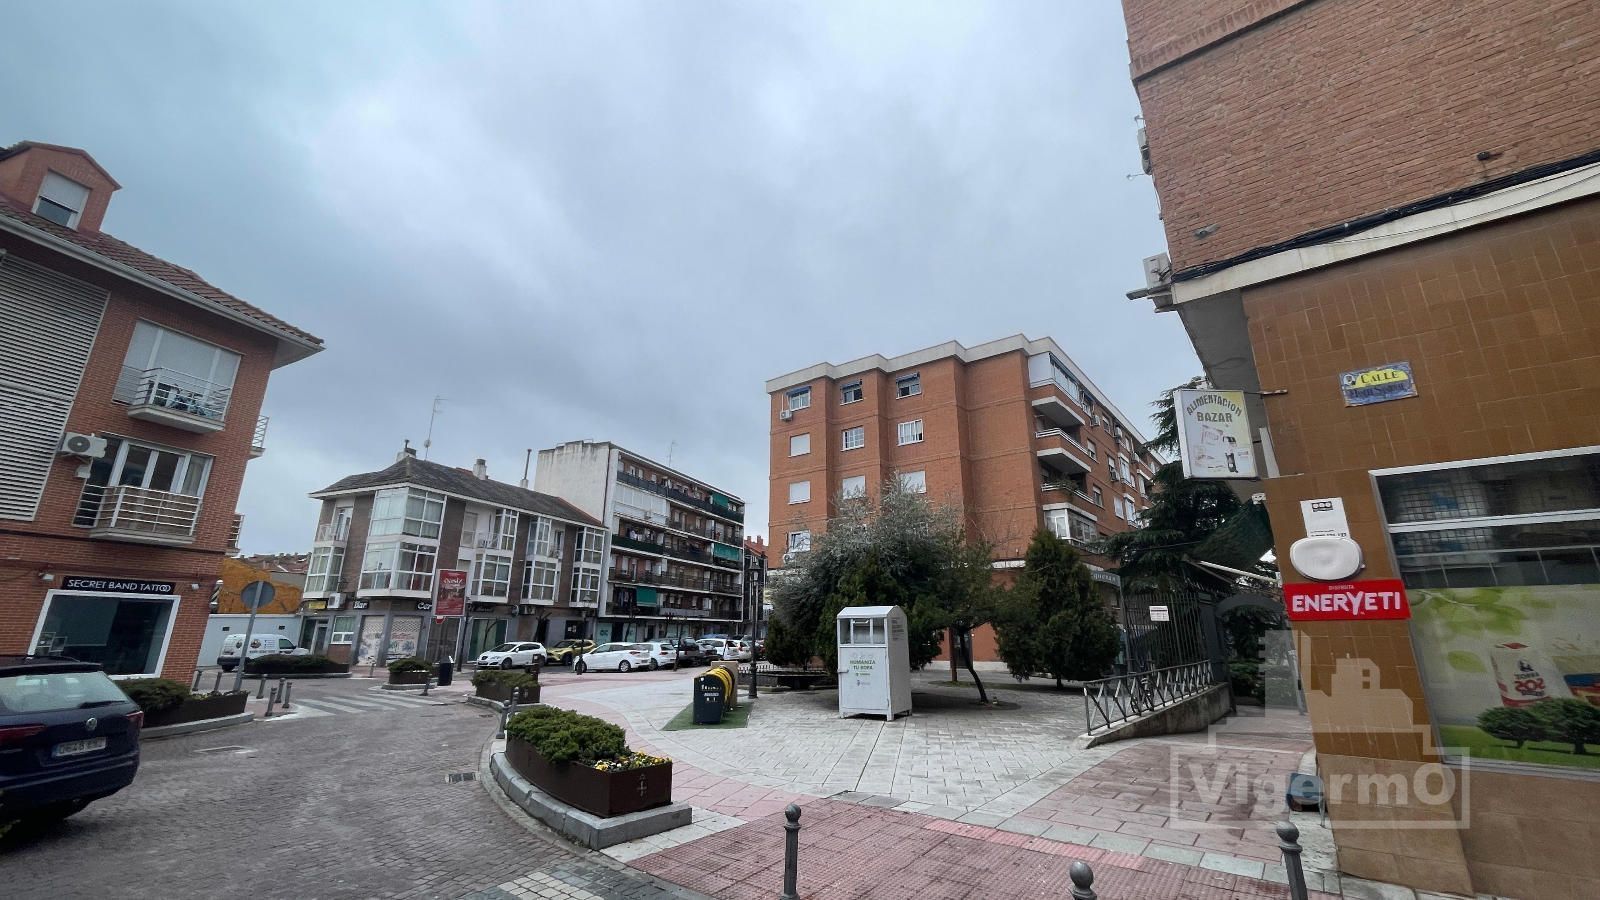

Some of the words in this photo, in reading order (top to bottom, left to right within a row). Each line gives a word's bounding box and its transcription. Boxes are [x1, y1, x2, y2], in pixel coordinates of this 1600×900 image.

[1186, 394, 1242, 417] ALIMENTACION
[1196, 411, 1233, 423] BAZAR
[67, 579, 106, 589] SECRET
[108, 581, 138, 591] BAND
[140, 583, 172, 593] TATTOO
[1292, 591, 1401, 616] ENERYETI
